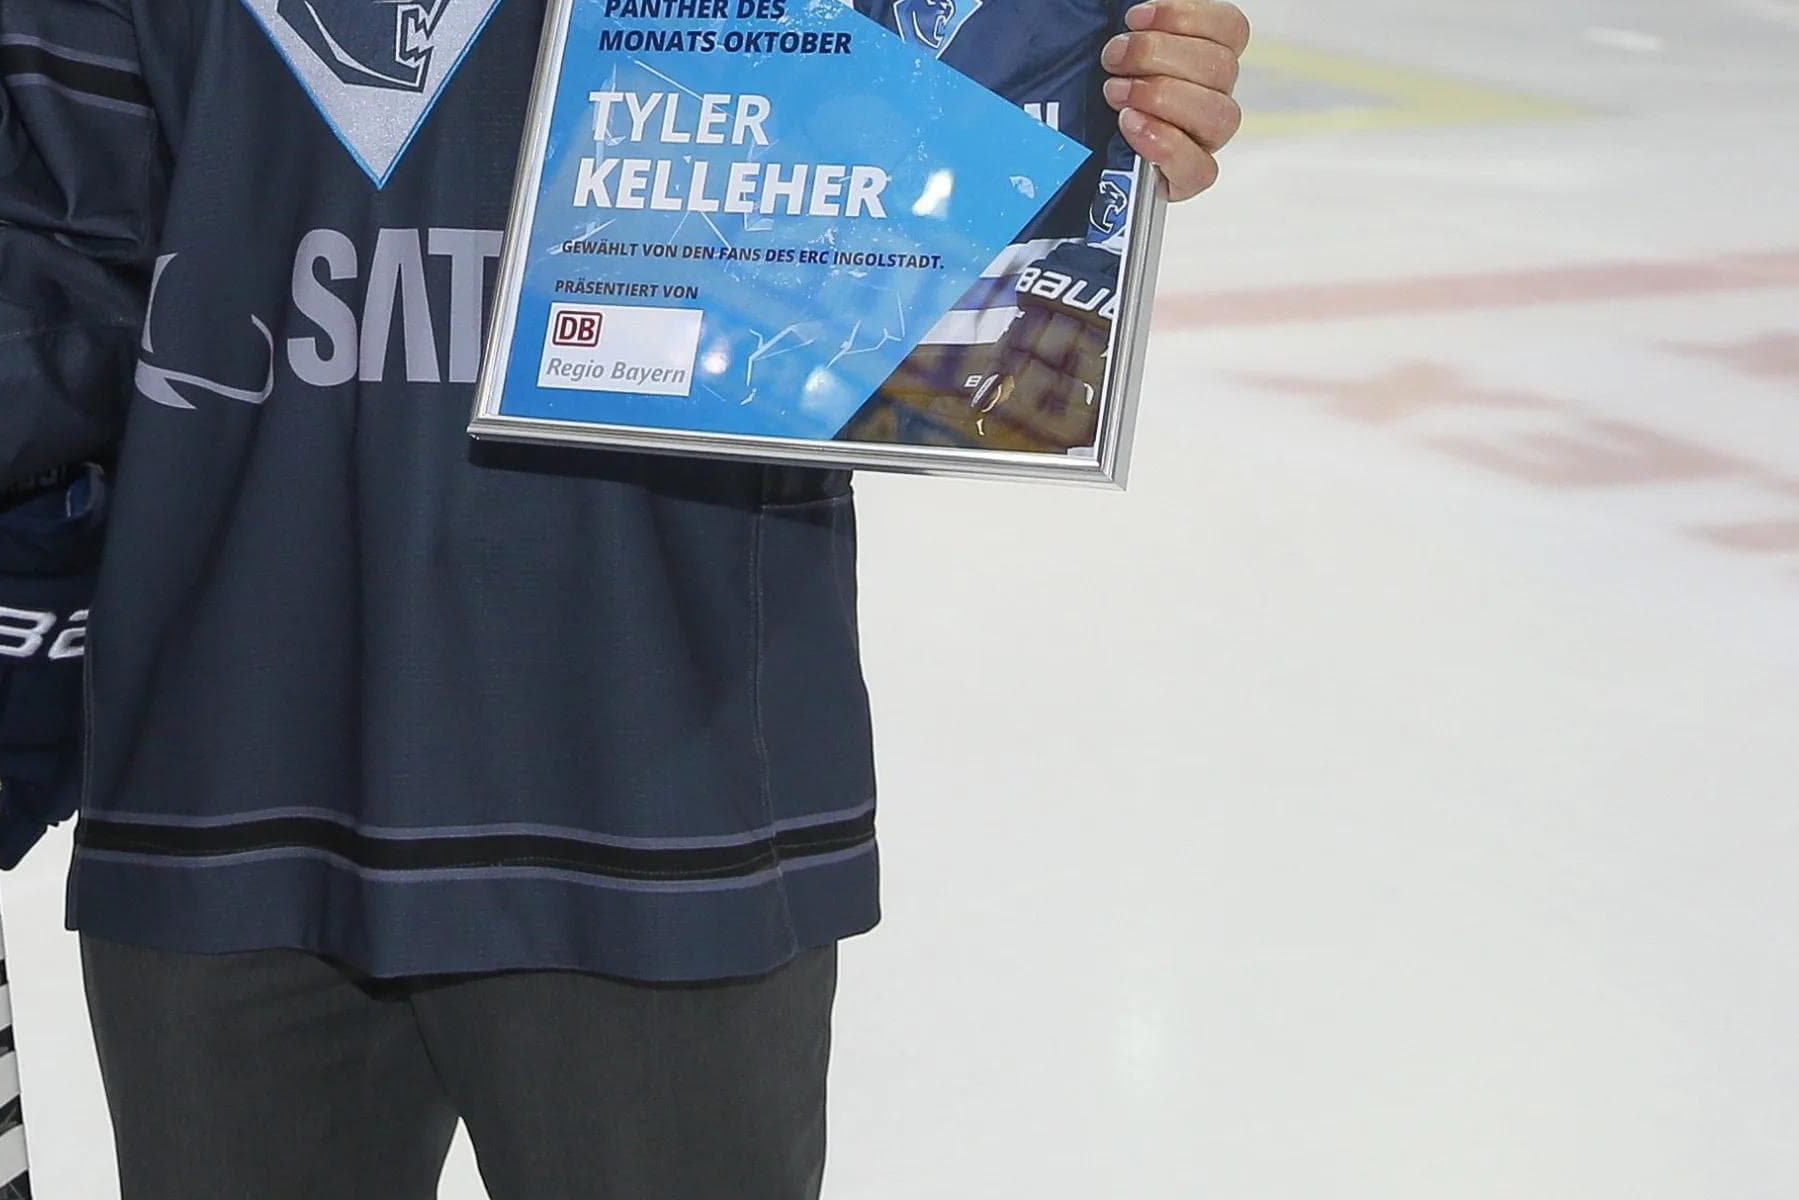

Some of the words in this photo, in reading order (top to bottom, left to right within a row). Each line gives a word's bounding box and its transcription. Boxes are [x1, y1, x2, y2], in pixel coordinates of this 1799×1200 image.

[598, 29, 716, 52] MONATS
[723, 31, 852, 55] OKTOBER
[589, 91, 772, 146] TYLER
[572, 157, 889, 219] KELLEHER
[562, 239, 638, 257] GEWÄHLT
[642, 244, 678, 258] VON
[682, 246, 720, 260] DEN
[720, 247, 761, 262] FANS
[765, 249, 795, 263] DES
[799, 250, 829, 265] ERC
[833, 250, 945, 270] INGOLSTADT.
[555, 278, 659, 297] PRÄSENTIERT
[663, 285, 699, 299] VON
[558, 316, 596, 342] DB
[546, 358, 604, 382] Regio
[611, 362, 686, 386] Bayern
